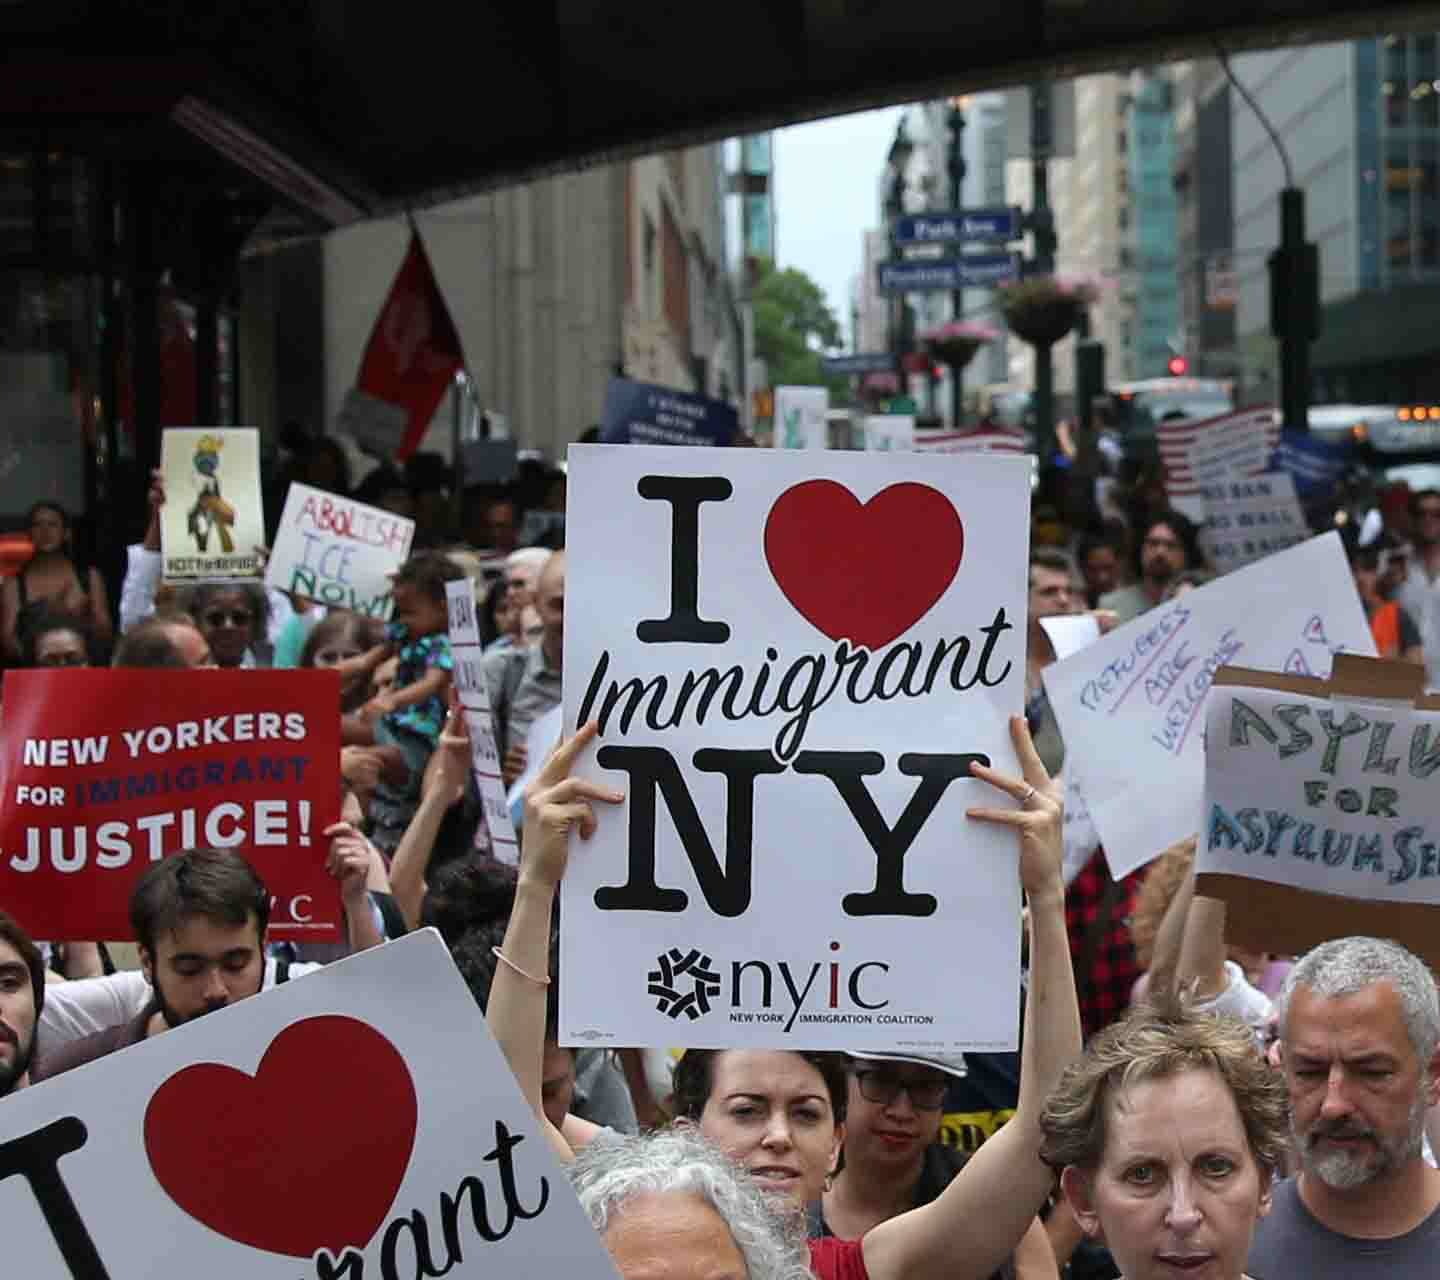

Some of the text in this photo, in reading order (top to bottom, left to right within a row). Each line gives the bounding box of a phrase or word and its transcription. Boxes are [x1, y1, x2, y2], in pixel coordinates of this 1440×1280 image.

[295, 494, 409, 548] ABOLISH
[302, 530, 357, 585] ICE
[637, 475, 733, 644] I
[575, 606, 1013, 761] Immigrant
[23, 712, 307, 767] NEW YORKERS
[15, 755, 311, 807] FOR IMMIGRANT
[1304, 781, 1401, 818] FOR
[9, 799, 313, 873] JUSTICE!
[593, 745, 991, 918] NY
[1208, 802, 1384, 873] ASYLUM
[731, 941, 889, 1032] nyic
[730, 1014, 934, 1025] NEW YORK IMMIGRATION COALITION
